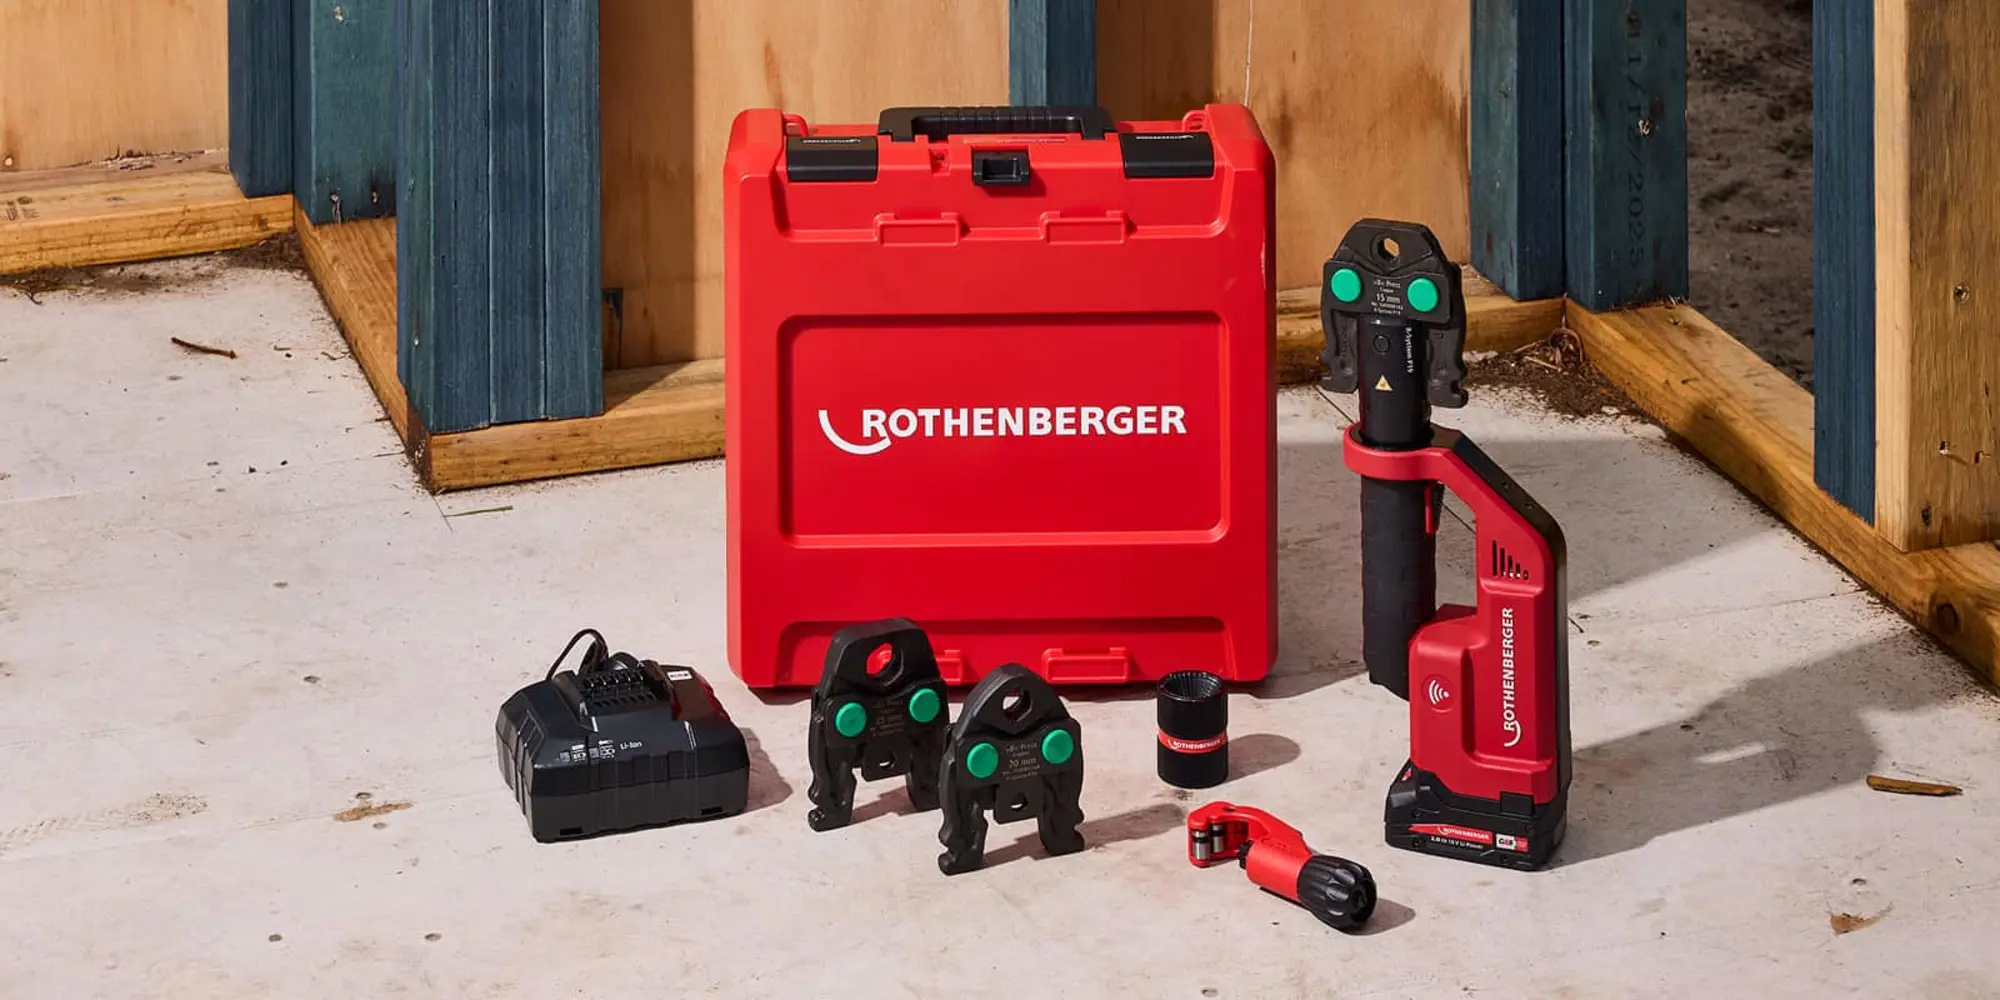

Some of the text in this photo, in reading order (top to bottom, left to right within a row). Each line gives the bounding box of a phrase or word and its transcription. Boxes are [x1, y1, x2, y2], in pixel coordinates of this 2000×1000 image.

[1376, 293, 1401, 304] 15 mm
[861, 405, 1188, 438] ROTHENBERGER
[1501, 607, 1515, 732] ROTHENBERGER
[1443, 827, 1489, 840] ROTHENBERGER
